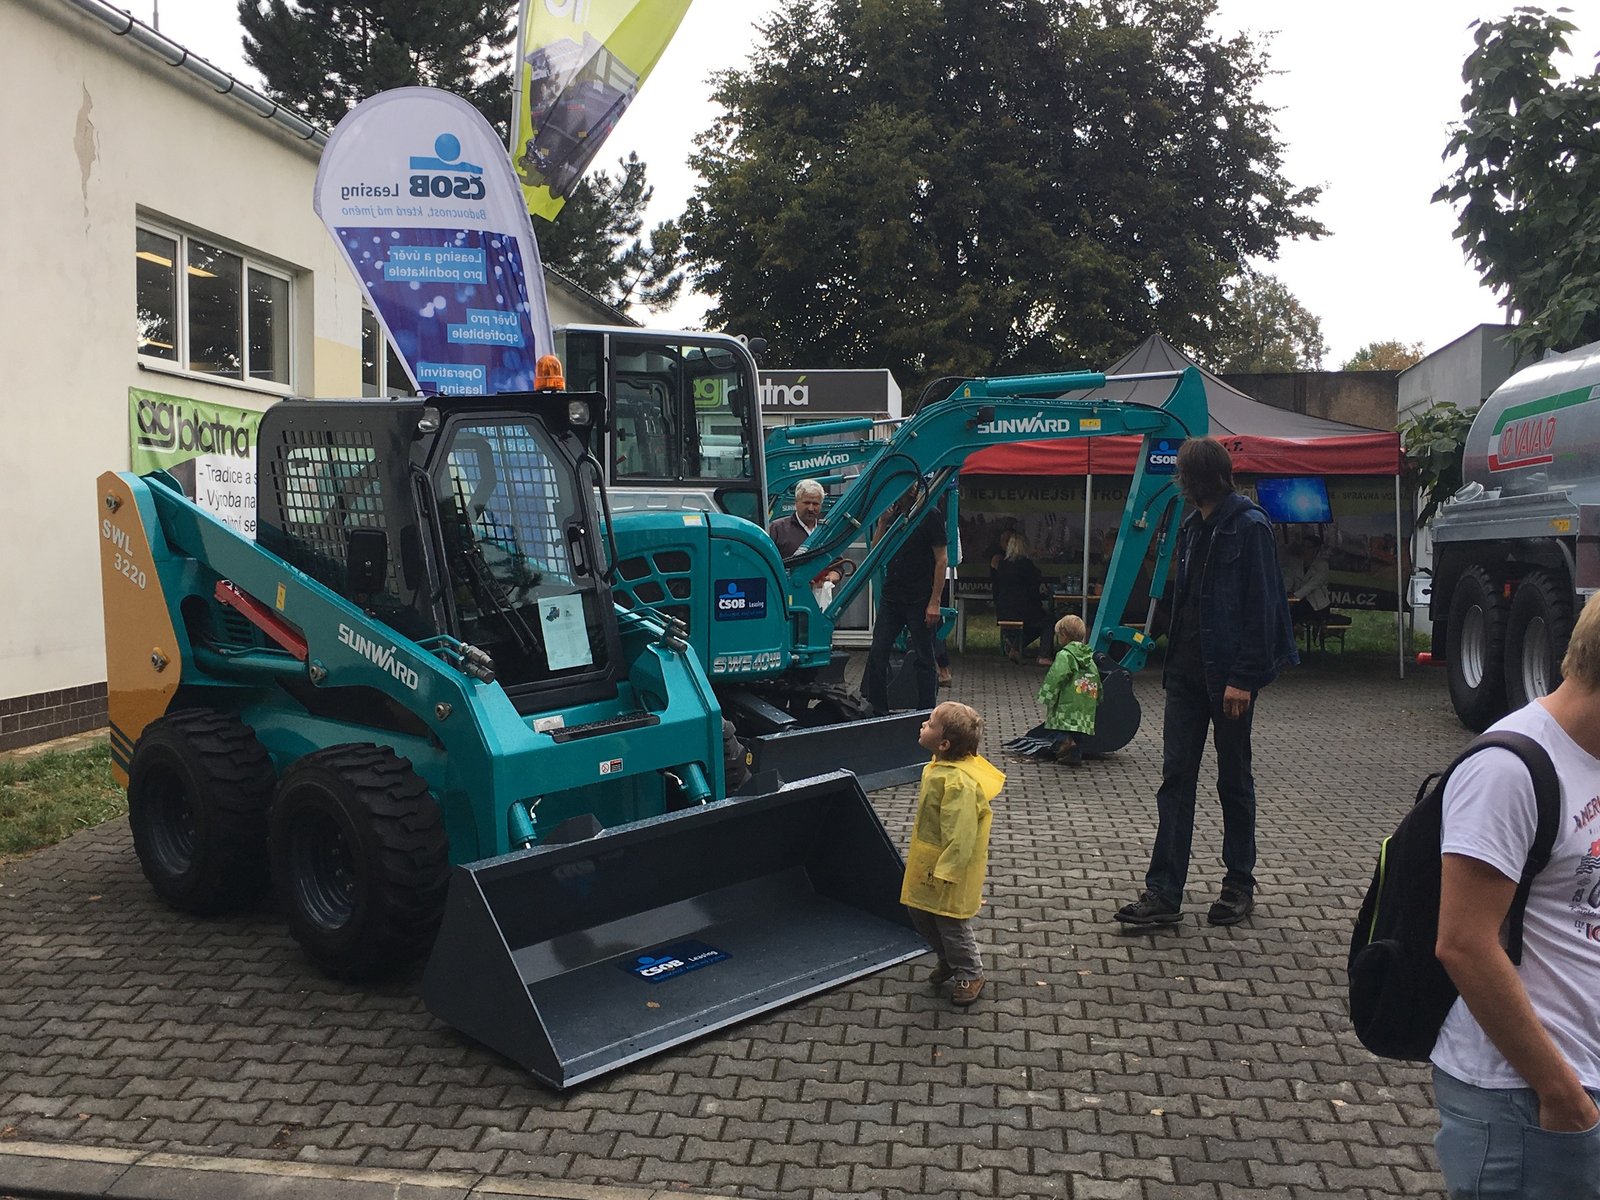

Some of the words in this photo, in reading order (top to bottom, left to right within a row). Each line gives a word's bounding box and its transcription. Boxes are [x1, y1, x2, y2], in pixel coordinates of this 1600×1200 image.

[205, 464, 243, 484] Tradice
[789, 451, 850, 471] SUNWARD
[103, 519, 133, 558] SWL
[114, 552, 147, 590] 3220
[337, 623, 419, 691] SUNWARD
